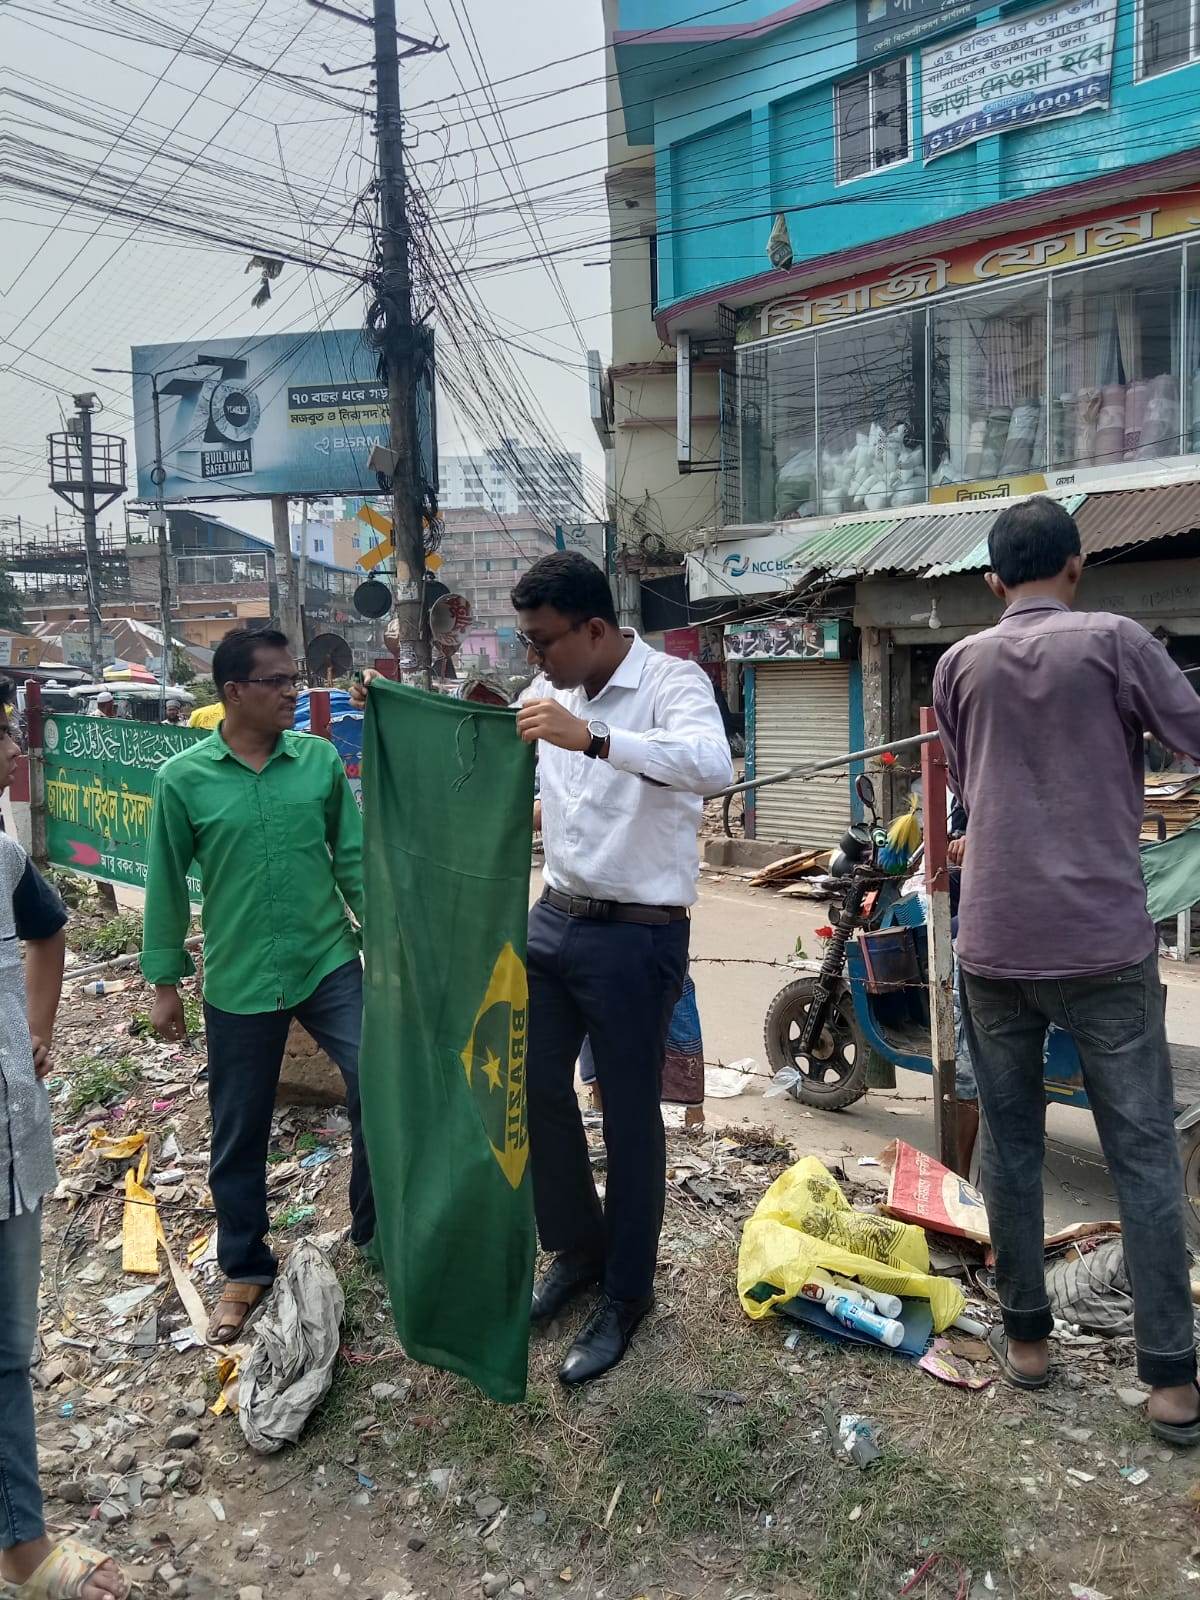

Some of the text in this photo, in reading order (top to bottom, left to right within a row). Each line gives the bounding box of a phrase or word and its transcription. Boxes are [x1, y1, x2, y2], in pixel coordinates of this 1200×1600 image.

[933, 50, 954, 67] এই
[1004, 22, 1029, 37] এর
[1058, 32, 1090, 48] জন্য
[927, 42, 1107, 118] ভাড়া দেওয়া হবে
[973, 208, 1162, 280] ফোম
[292, 393, 309, 405] ৭০
[311, 391, 339, 403] বছর
[341, 390, 365, 402] ধরে
[290, 412, 325, 426] মজবুত
[327, 411, 336, 421] ও
[339, 408, 379, 421] নিরাপদ
[333, 436, 380, 449] BSRM
[204, 449, 249, 465] BUILDING A
[205, 461, 250, 475] SAFER NATION
[752, 561, 774, 573] NCC
[120, 777, 154, 840] ইসলা
[100, 854, 116, 875] আবু
[117, 857, 134, 875] বকর
[135, 862, 149, 883] সড়
